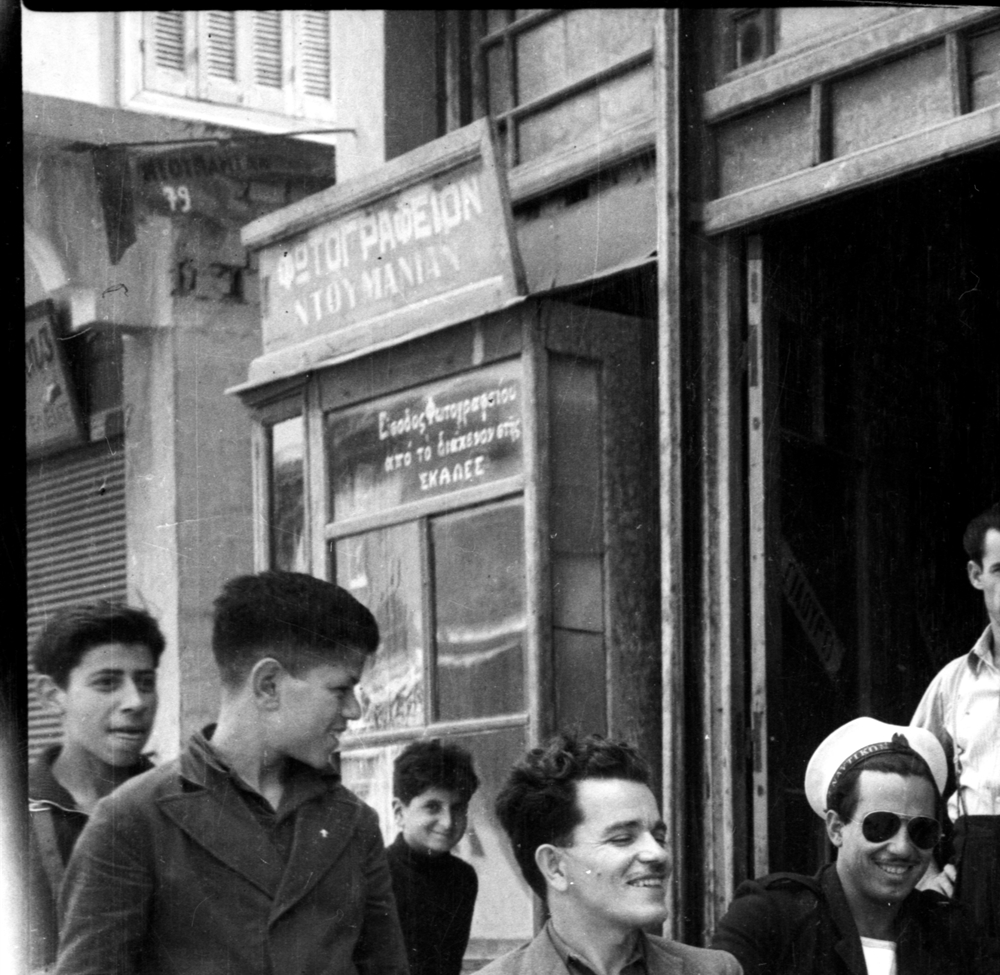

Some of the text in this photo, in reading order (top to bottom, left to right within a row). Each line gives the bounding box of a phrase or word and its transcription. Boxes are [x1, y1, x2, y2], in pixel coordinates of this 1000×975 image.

[161, 184, 192, 213] 79
[276, 176, 483, 291] ΦΩΤΟΓΡΑΦΕΙΟΝ
[418, 455, 485, 491] ΣΚΑΛΕΣ
